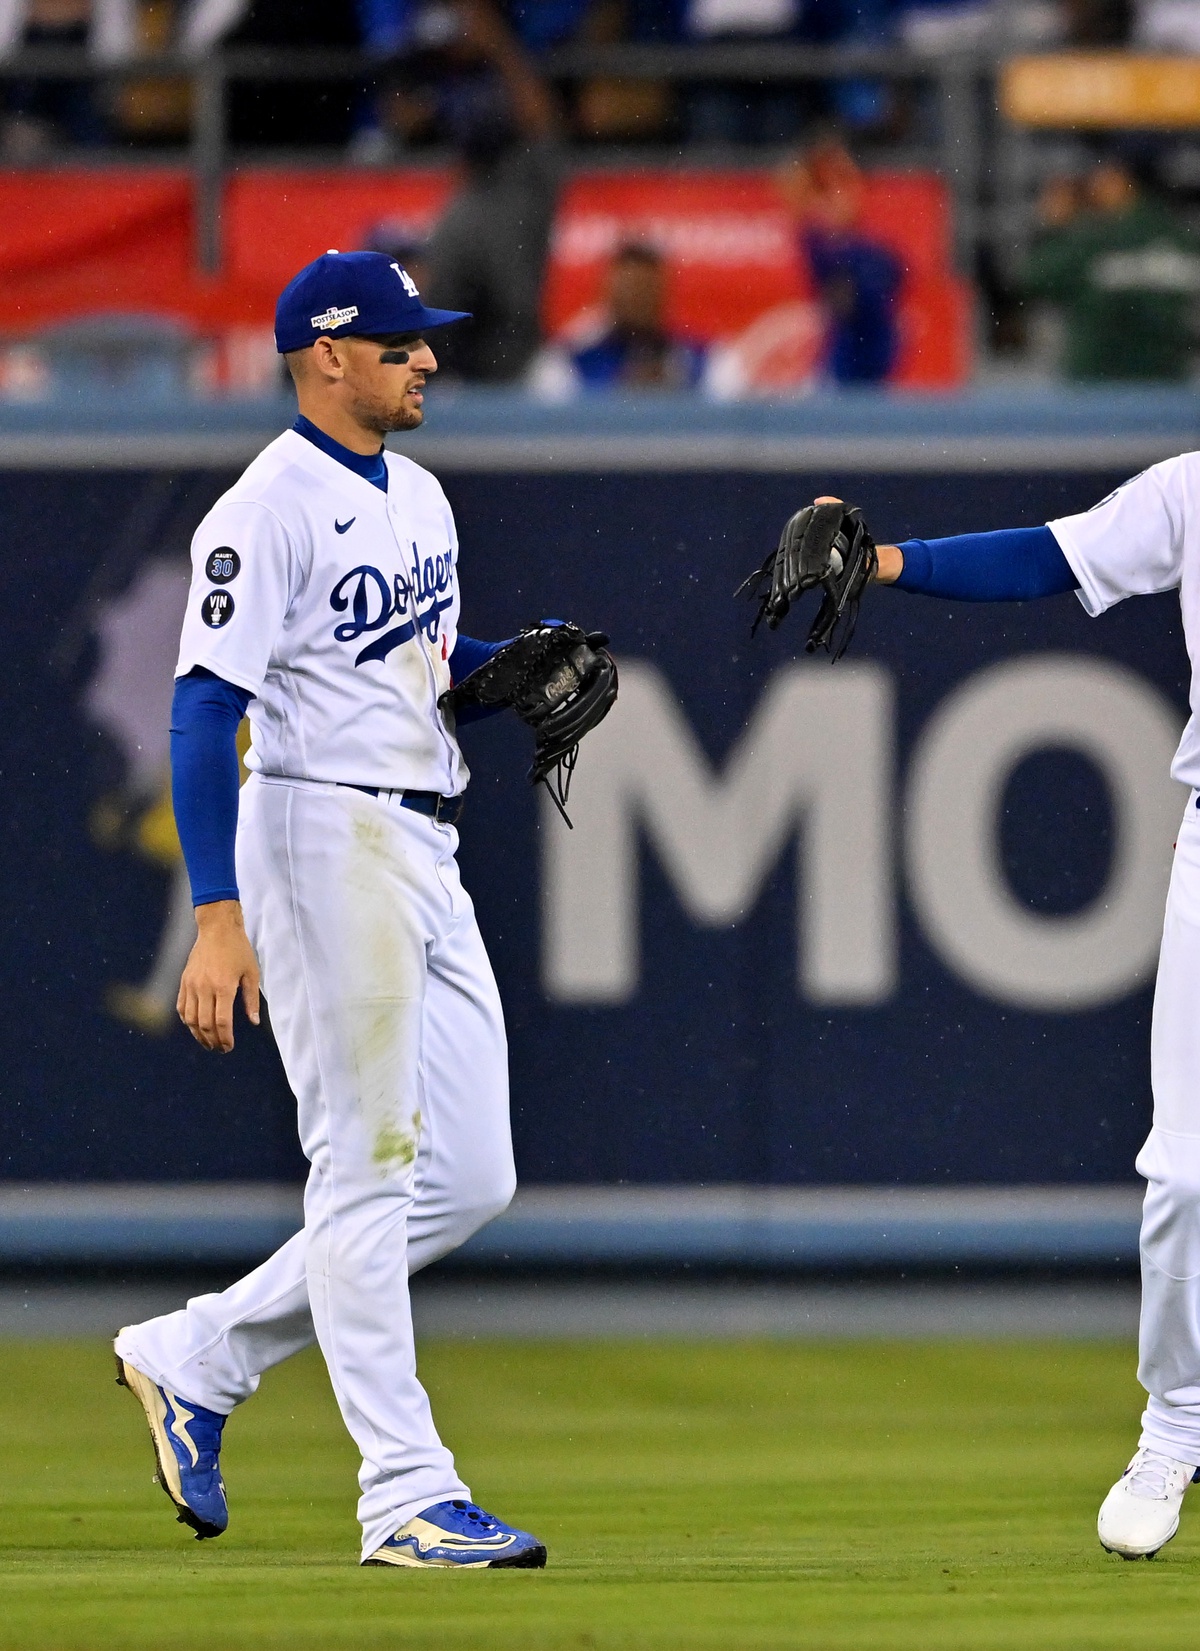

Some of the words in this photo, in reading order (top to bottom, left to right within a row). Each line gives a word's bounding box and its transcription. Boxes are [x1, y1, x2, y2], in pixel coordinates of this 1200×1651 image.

[390, 263, 419, 297] LA
[313, 309, 356, 325] POSTSEASON
[211, 559, 234, 576] 30
[210, 595, 228, 609] VIN
[329, 541, 455, 646] Dodger
